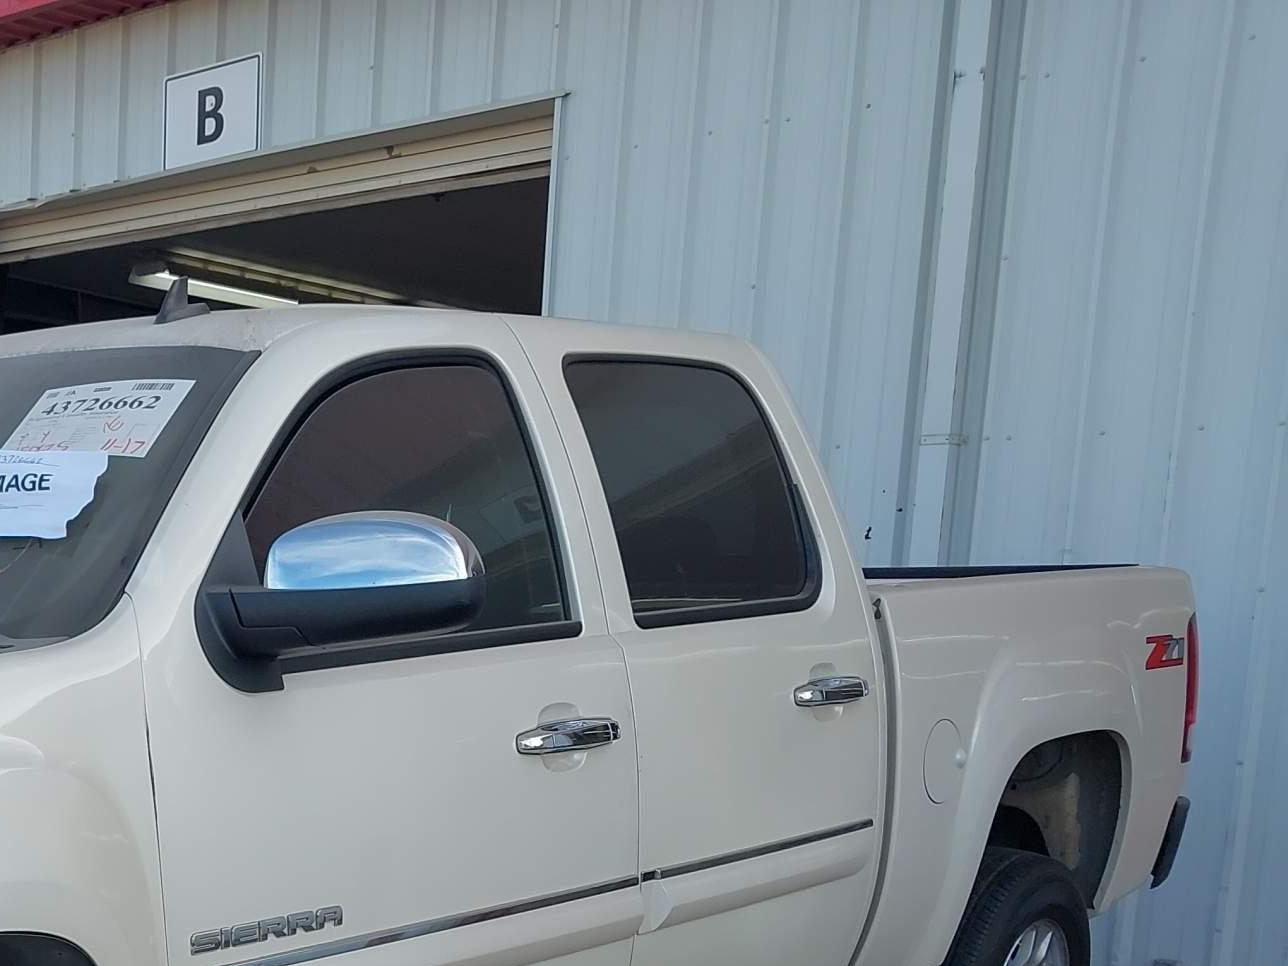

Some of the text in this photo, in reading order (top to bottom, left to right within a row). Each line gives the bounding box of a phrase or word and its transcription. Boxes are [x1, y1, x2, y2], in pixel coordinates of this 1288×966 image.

[196, 86, 224, 146] B
[41, 395, 162, 416] 43726662
[1145, 634, 1185, 671] Z71
[190, 905, 344, 956] SIERRA
